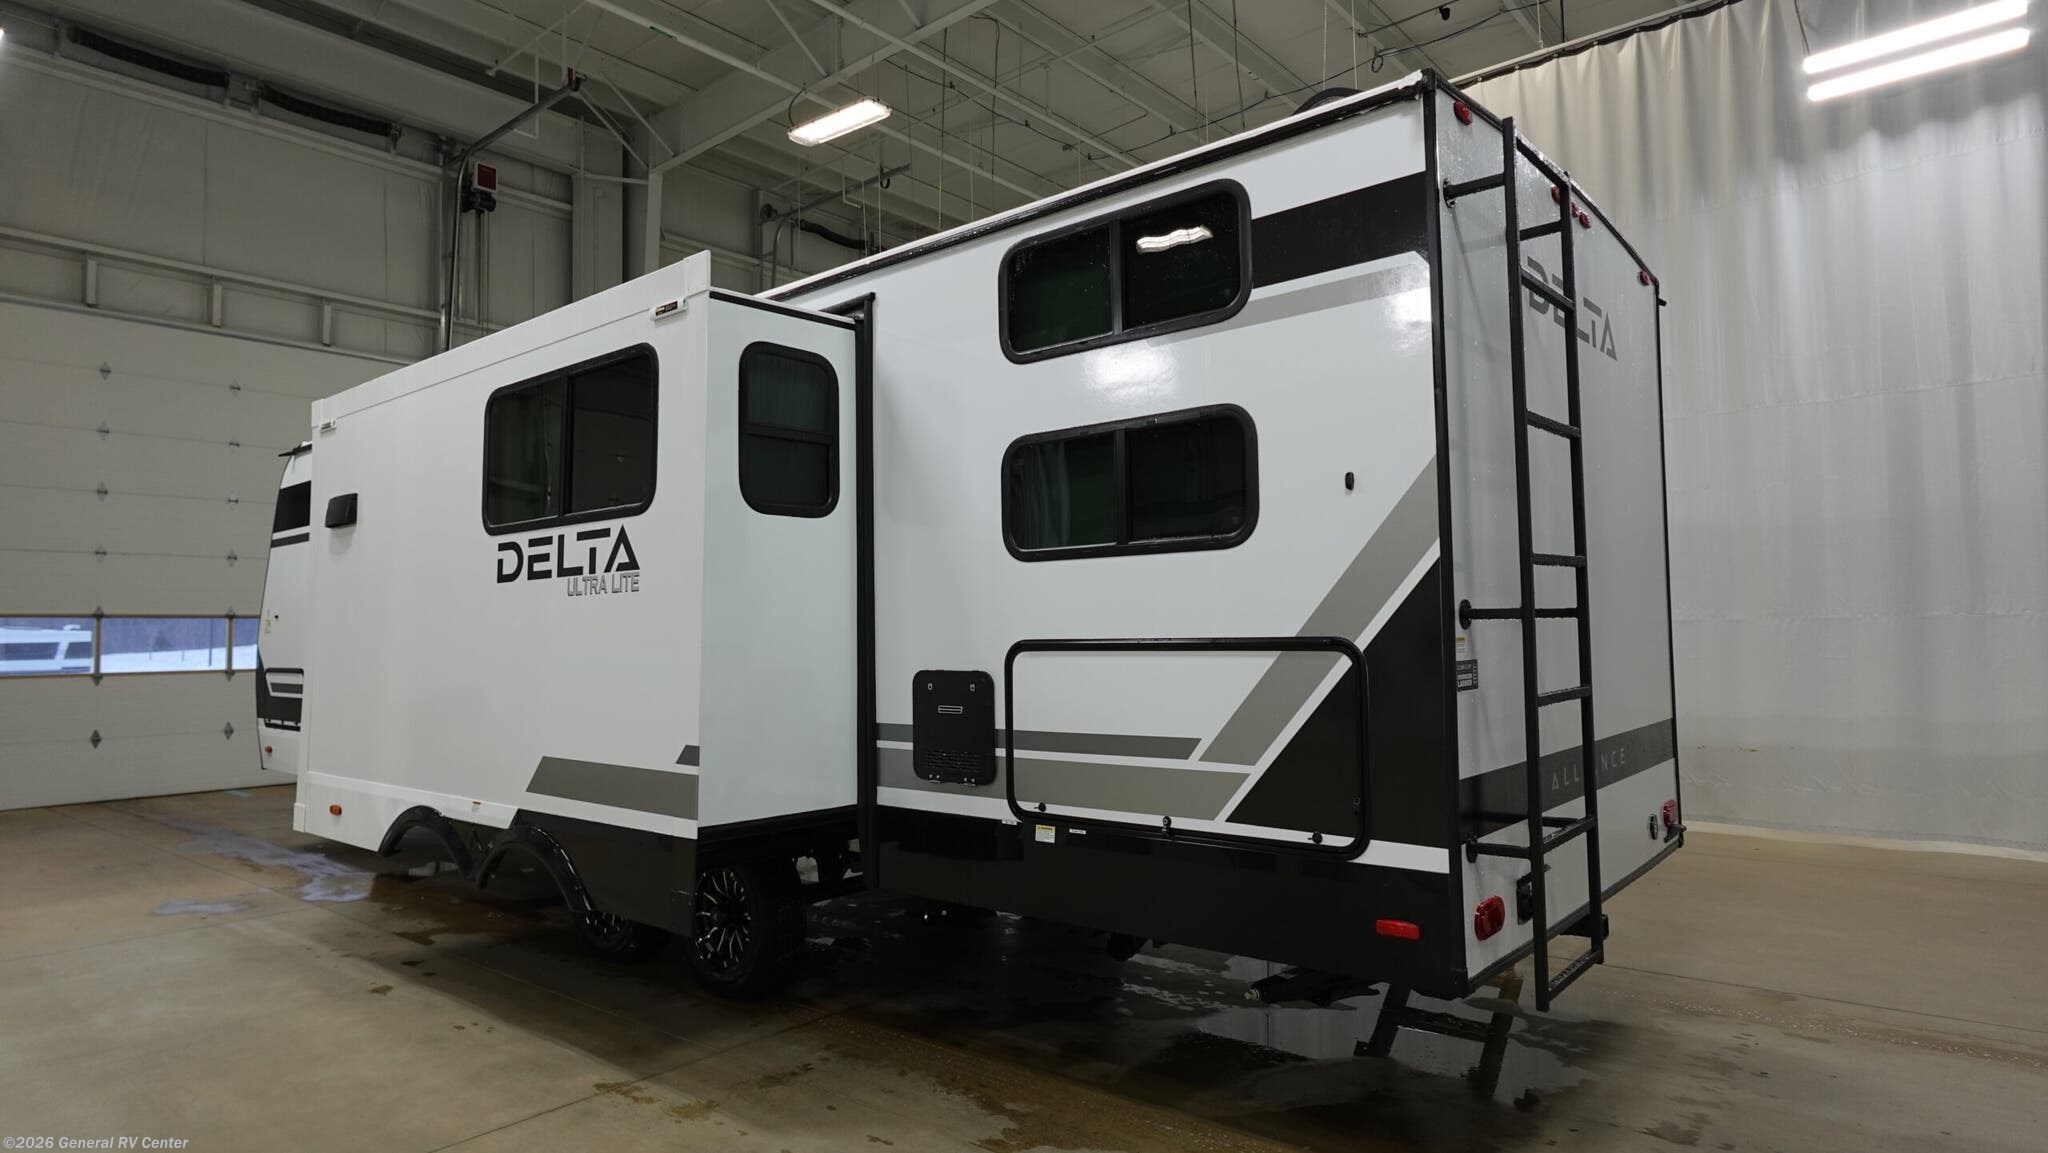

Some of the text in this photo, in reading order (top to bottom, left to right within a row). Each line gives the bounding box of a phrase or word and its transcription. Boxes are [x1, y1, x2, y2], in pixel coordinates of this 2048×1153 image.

[497, 524, 640, 583] DELTA
[567, 573, 640, 596] ULTRA LITE
[1552, 747, 1625, 791] ALLNCE
